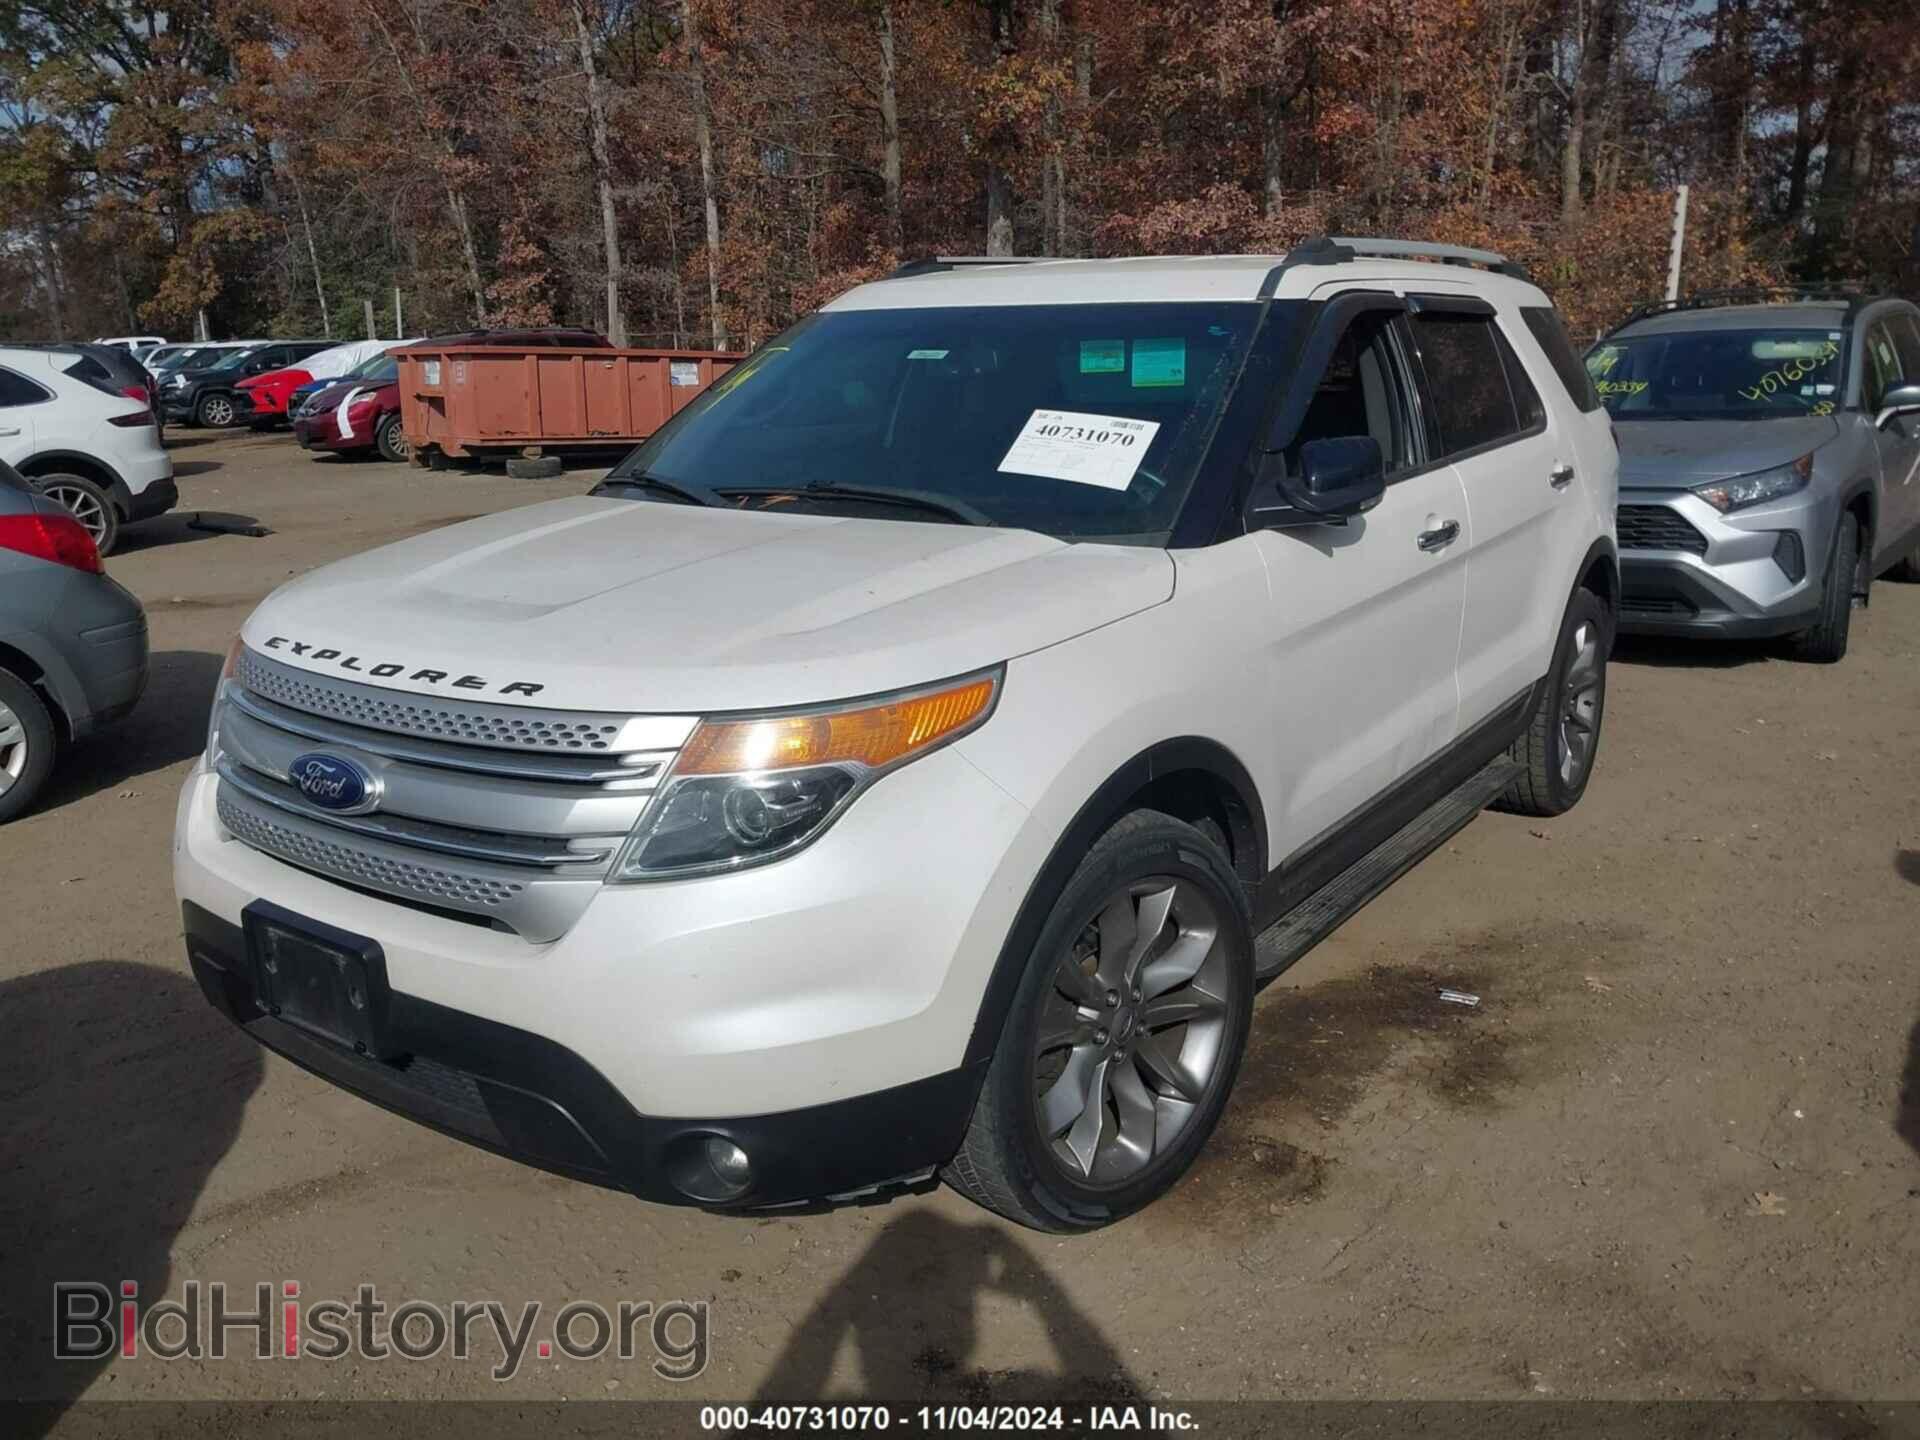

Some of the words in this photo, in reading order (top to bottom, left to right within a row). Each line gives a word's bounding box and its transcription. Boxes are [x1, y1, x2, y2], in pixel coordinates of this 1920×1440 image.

[1035, 424, 1135, 447] 40731070
[264, 636, 545, 697] EXPLORER
[301, 760, 347, 798] Ford
